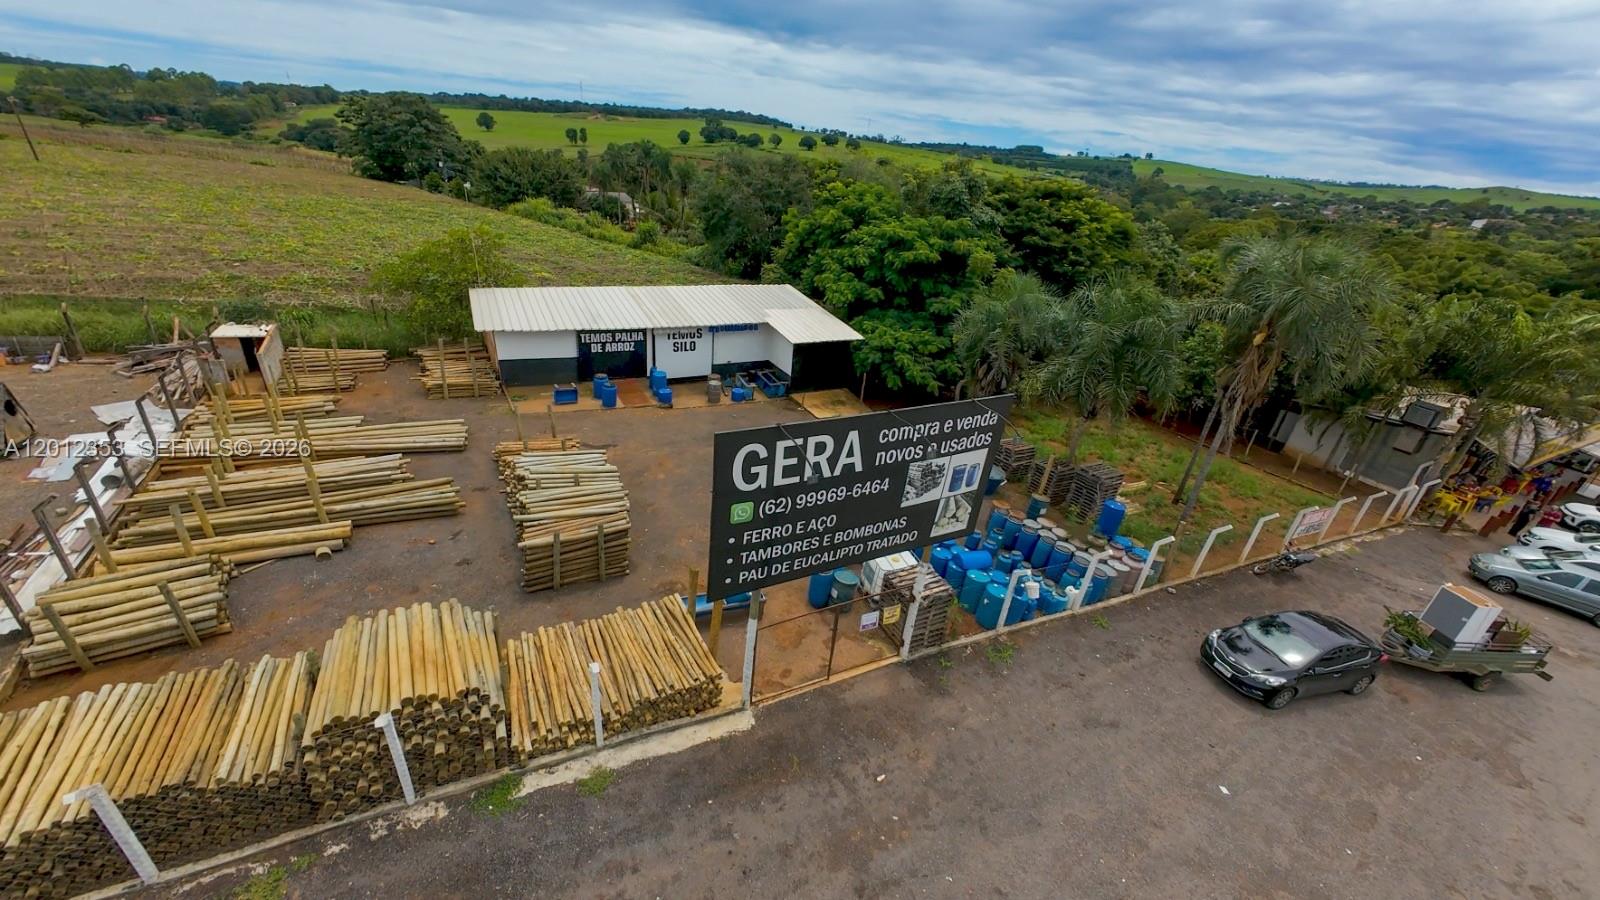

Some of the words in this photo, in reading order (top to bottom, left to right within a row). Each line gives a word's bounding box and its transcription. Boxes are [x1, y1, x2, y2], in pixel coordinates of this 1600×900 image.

[580, 333, 612, 343] TEMOS
[615, 331, 644, 342] PALHA
[591, 344, 603, 353] DE
[605, 342, 635, 352] ARROZ
[672, 341, 696, 352] SILO
[879, 421, 940, 444] compra
[944, 419, 953, 433] e
[957, 410, 998, 431] venda
[732, 430, 864, 492] GERA
[875, 444, 924, 466] novos
[940, 432, 993, 454] usados
[758, 496, 792, 518] (62)
[796, 478, 889, 509] 99969-6464
[740, 537, 820, 565] TAMBORES
[822, 534, 833, 546] E
[834, 516, 907, 544] BOMBONAS
[742, 523, 793, 545] FERRO
[796, 520, 806, 534] E
[807, 514, 837, 532] AÇO
[738, 566, 768, 584] PAU
[770, 561, 791, 576] DE
[793, 543, 863, 571] EUCALIPTO
[866, 530, 918, 552] TRATADO
